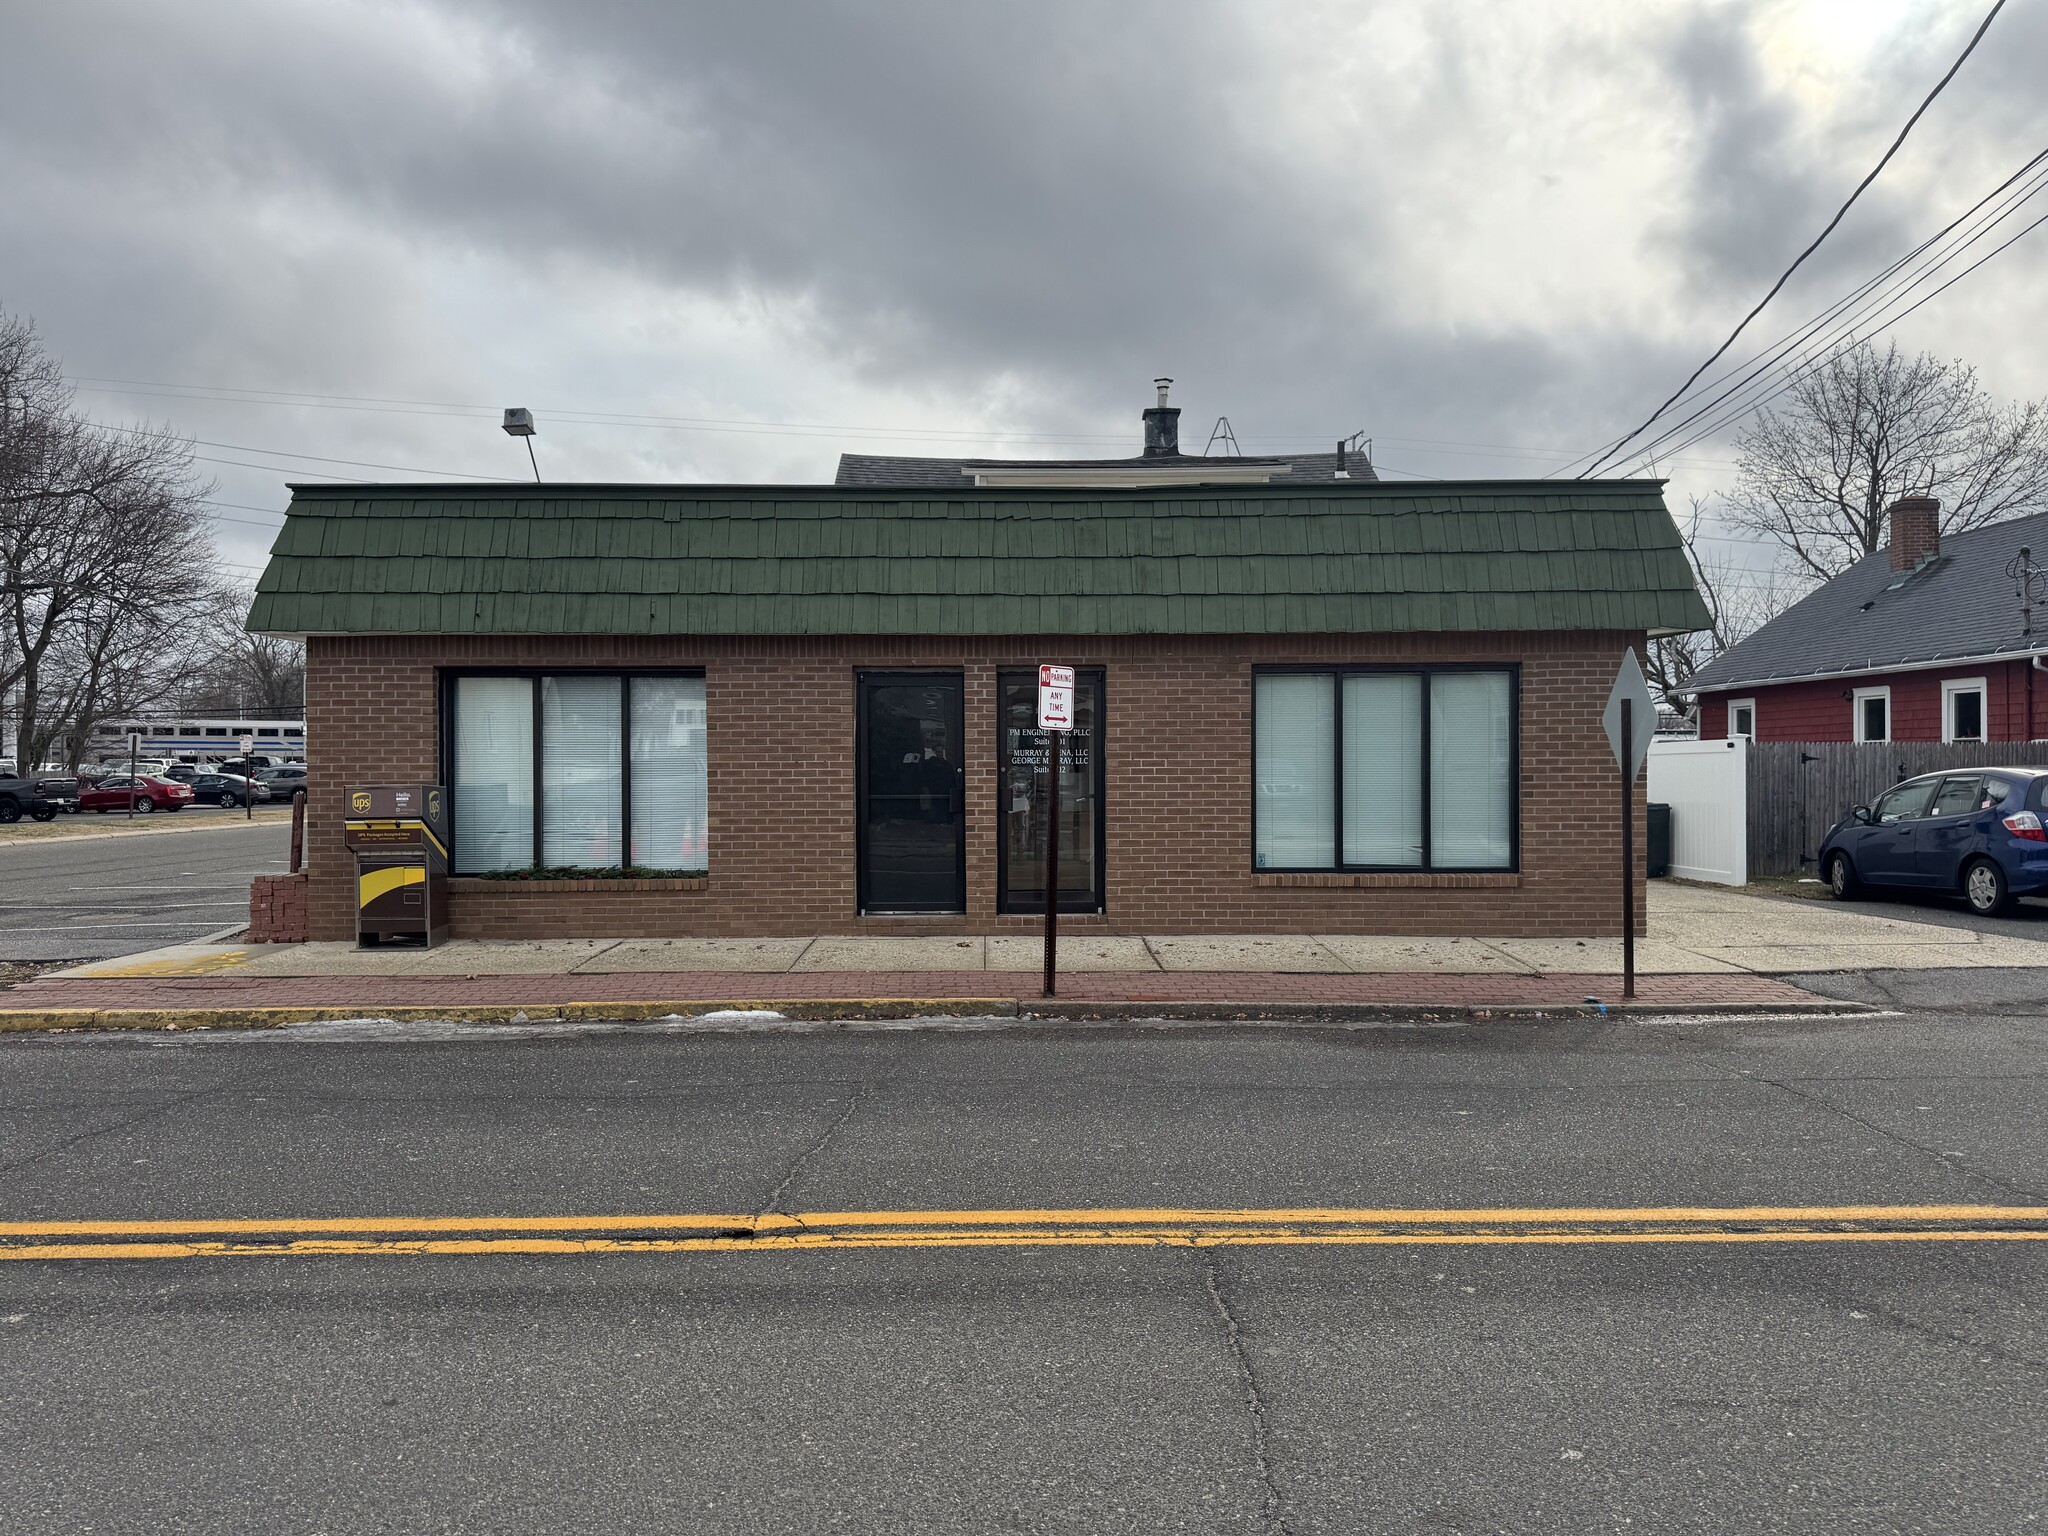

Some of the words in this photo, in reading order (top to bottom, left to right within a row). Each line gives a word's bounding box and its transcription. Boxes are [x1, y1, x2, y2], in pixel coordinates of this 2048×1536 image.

[1041, 670, 1050, 683] NO
[1051, 673, 1072, 683] PARKING
[1050, 691, 1063, 700] ANY
[1049, 702, 1064, 712] TIME
[1009, 728, 1021, 736] PM
[1022, 728, 1072, 737] ENGINENG,
[1073, 728, 1091, 736] PLLC
[1013, 749, 1043, 757] MURRAY
[1011, 757, 1041, 765] GEORGE
[1042, 757, 1074, 765] MRAY,
[1075, 757, 1089, 765] LLC
[1033, 766, 1050, 774] Suit
[353, 798, 370, 811] ups
[429, 800, 440, 818] ups
